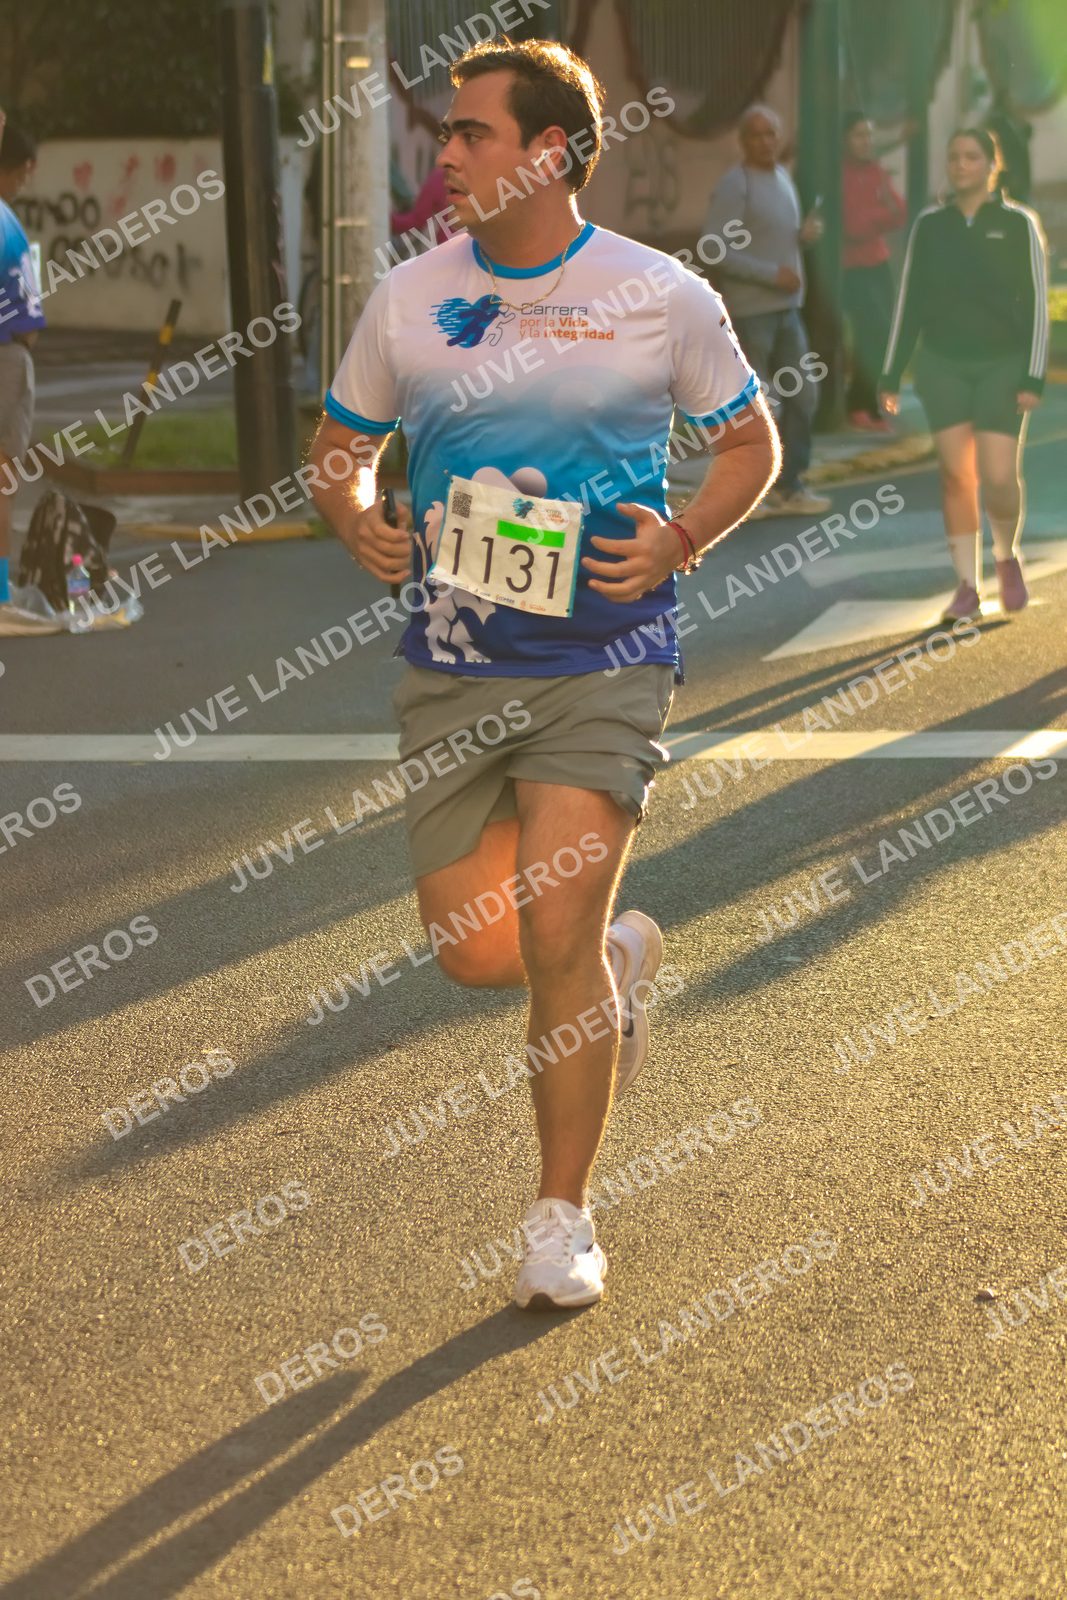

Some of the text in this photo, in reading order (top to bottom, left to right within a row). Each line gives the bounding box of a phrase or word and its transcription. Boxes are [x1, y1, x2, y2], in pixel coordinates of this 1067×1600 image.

[520, 302, 587, 316] Carrera
[520, 317, 539, 328] por
[544, 317, 555, 327] la
[519, 329, 525, 338] y
[529, 328, 540, 338] la
[452, 527, 560, 600] 1131
